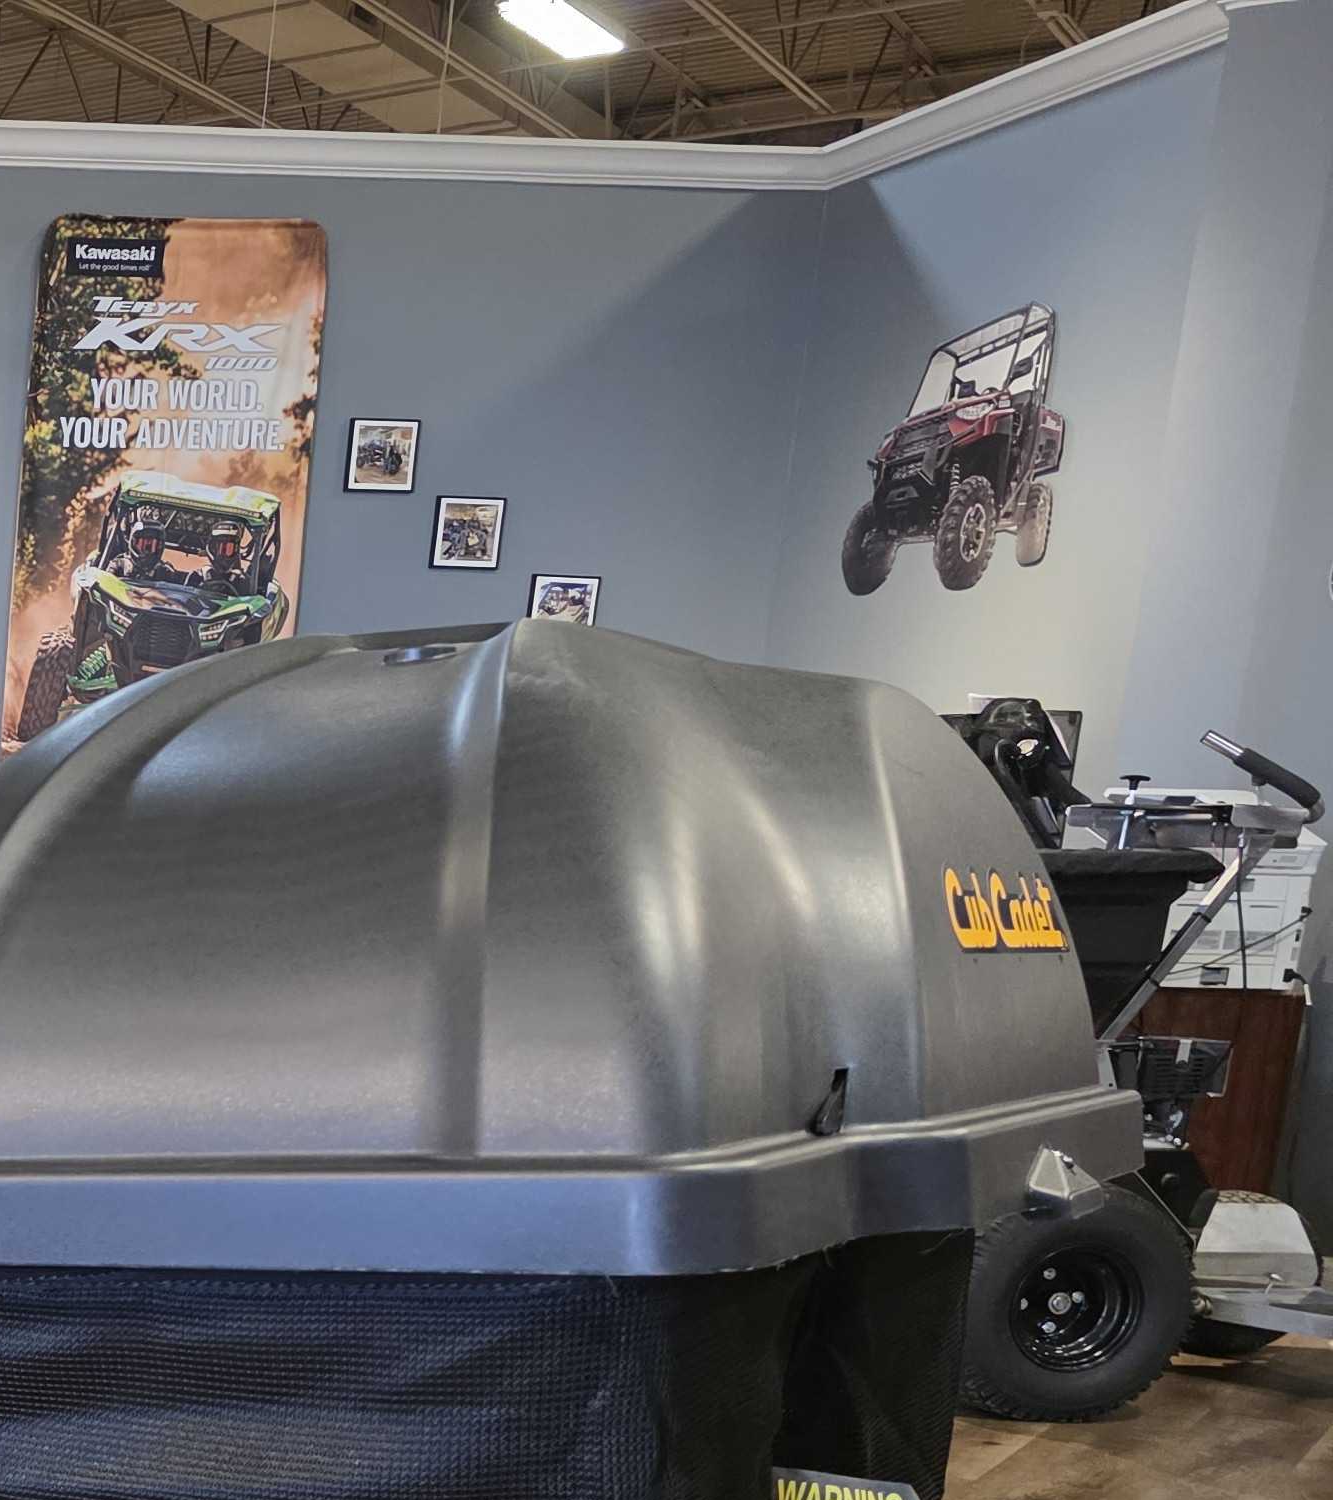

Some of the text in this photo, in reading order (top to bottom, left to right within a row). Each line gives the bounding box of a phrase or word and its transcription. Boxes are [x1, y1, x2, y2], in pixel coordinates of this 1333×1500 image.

[75, 243, 156, 261] Kawasaki
[102, 264, 119, 272] good
[73, 316, 283, 352] KRX
[205, 356, 278, 371] 1000
[90, 378, 263, 412] YOUR WORLD.
[60, 416, 285, 450] YOUR ADVENTURE.
[943, 866, 1067, 949] Cub Cadet
